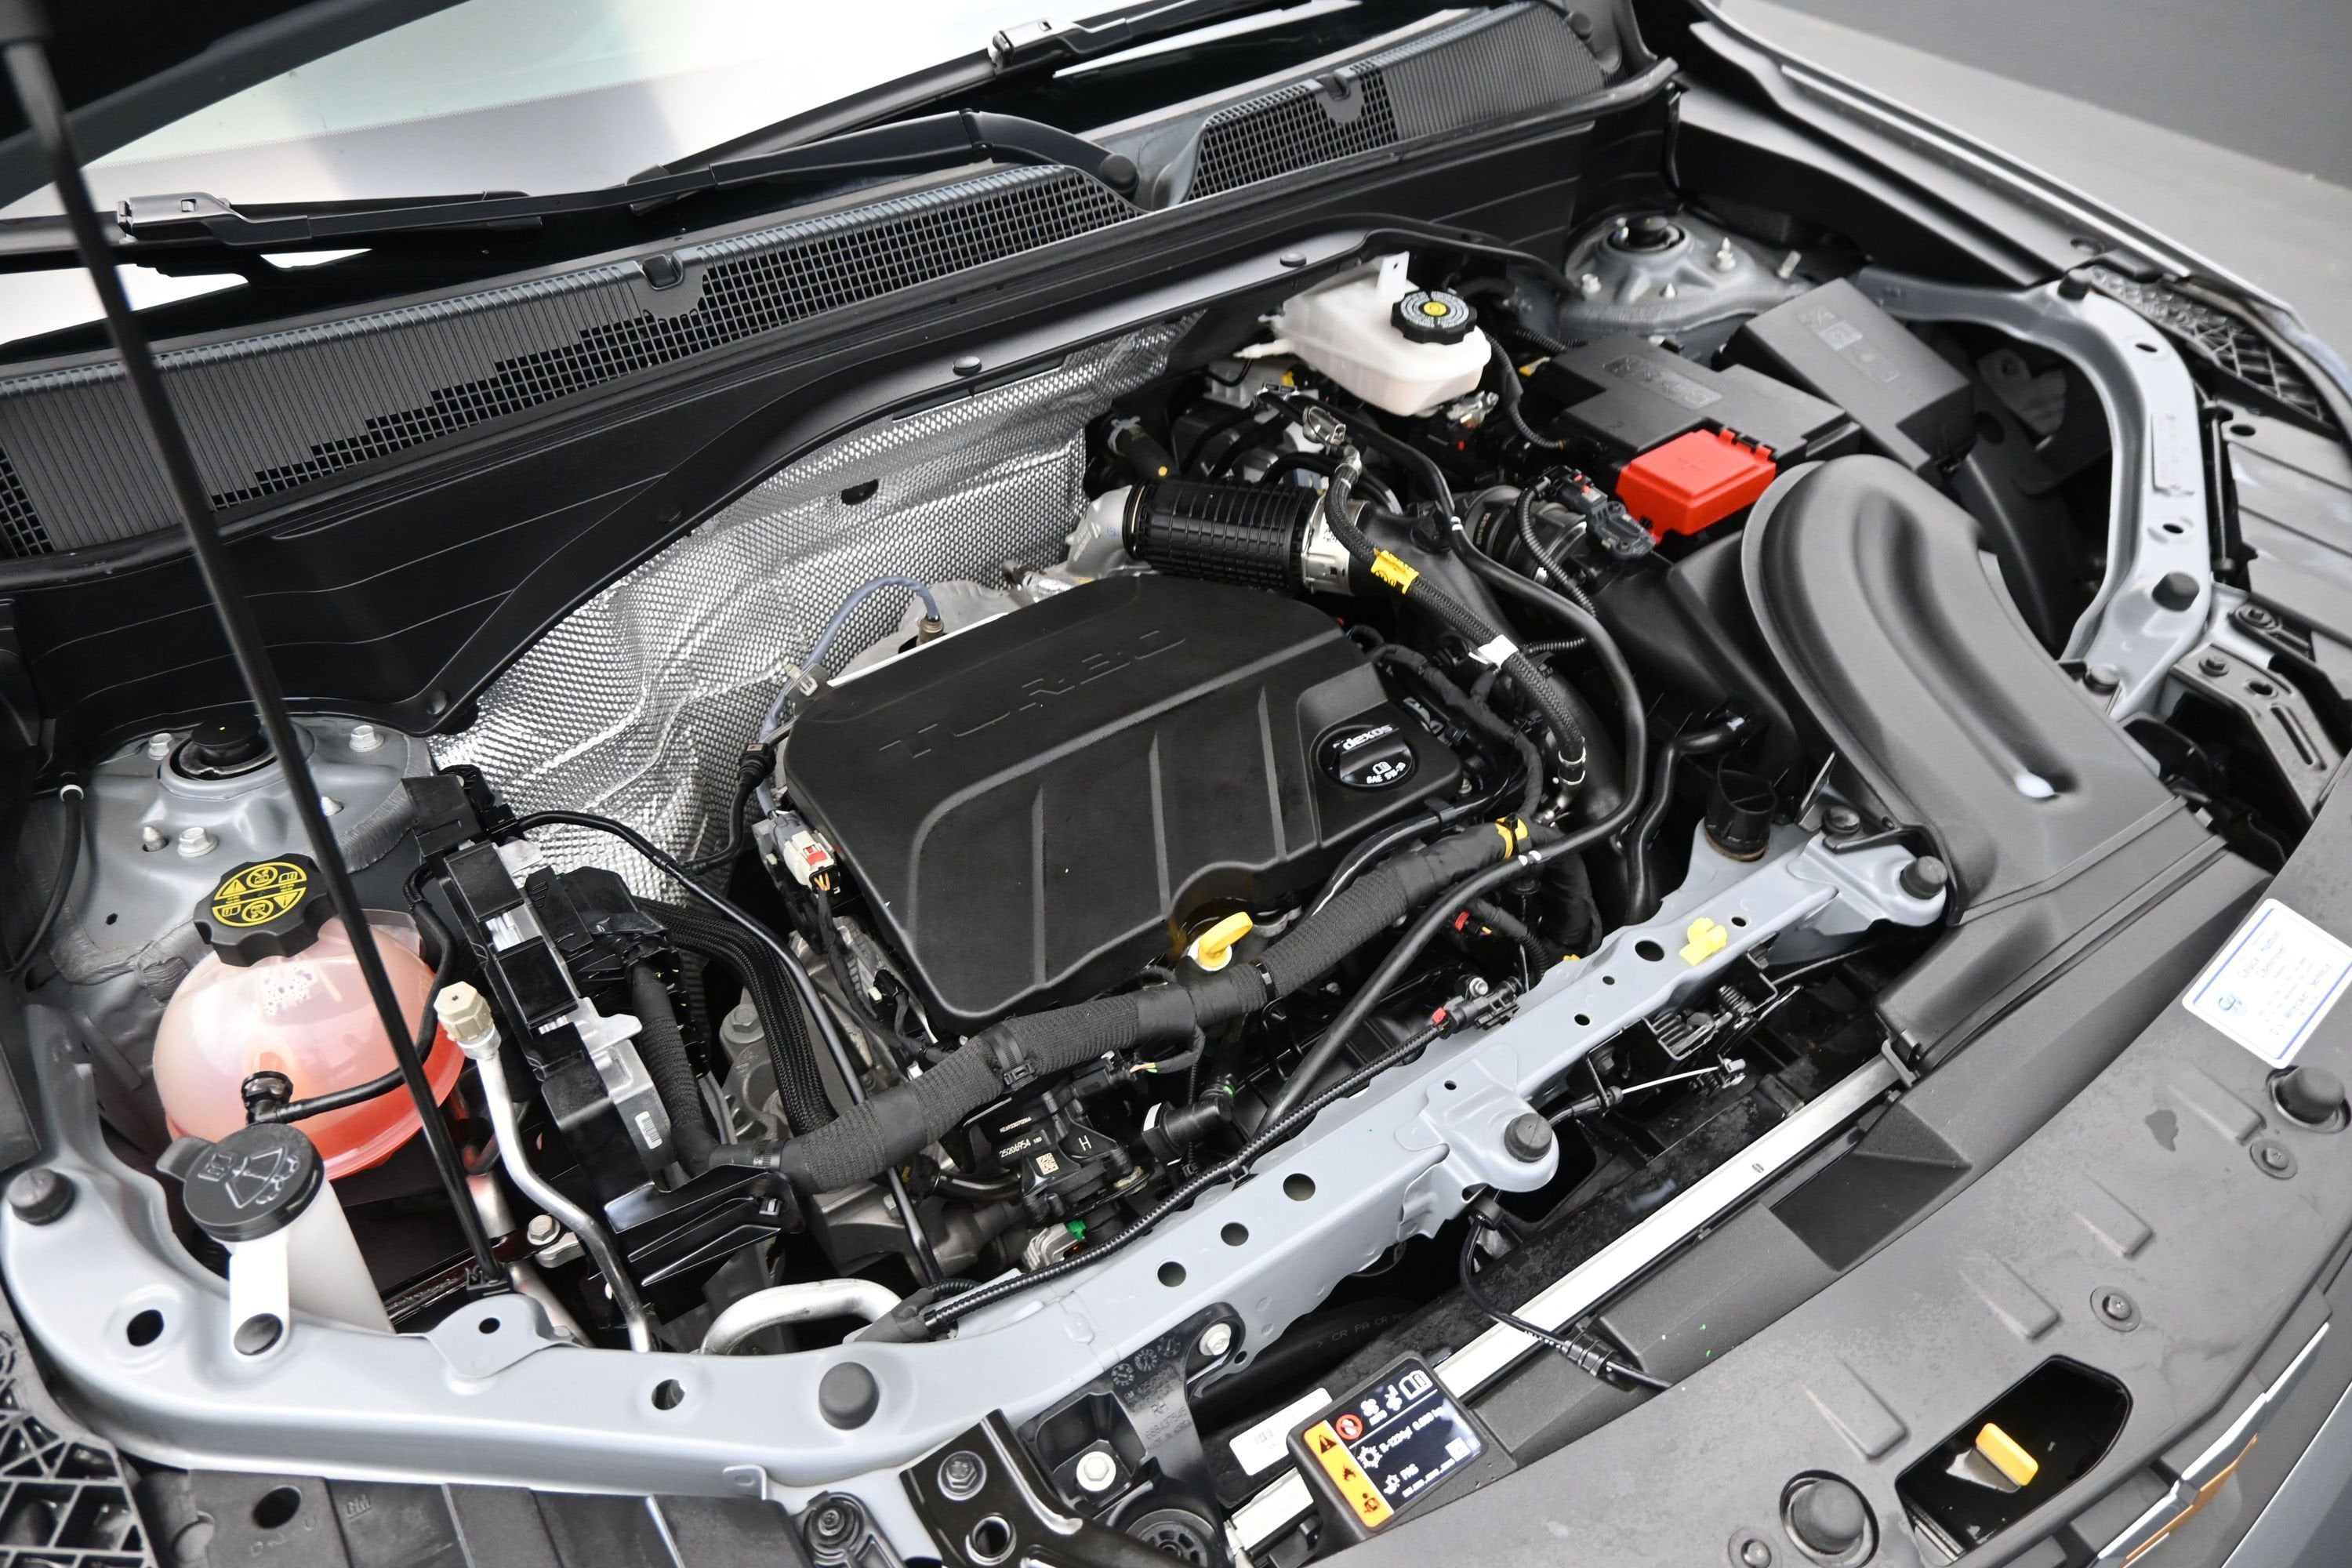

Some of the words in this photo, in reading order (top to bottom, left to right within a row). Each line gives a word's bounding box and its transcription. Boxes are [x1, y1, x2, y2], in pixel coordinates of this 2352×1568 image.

[879, 630, 1186, 759] TURBO
[1342, 724, 1393, 750] dexos
[1078, 1134, 1092, 1151] H
